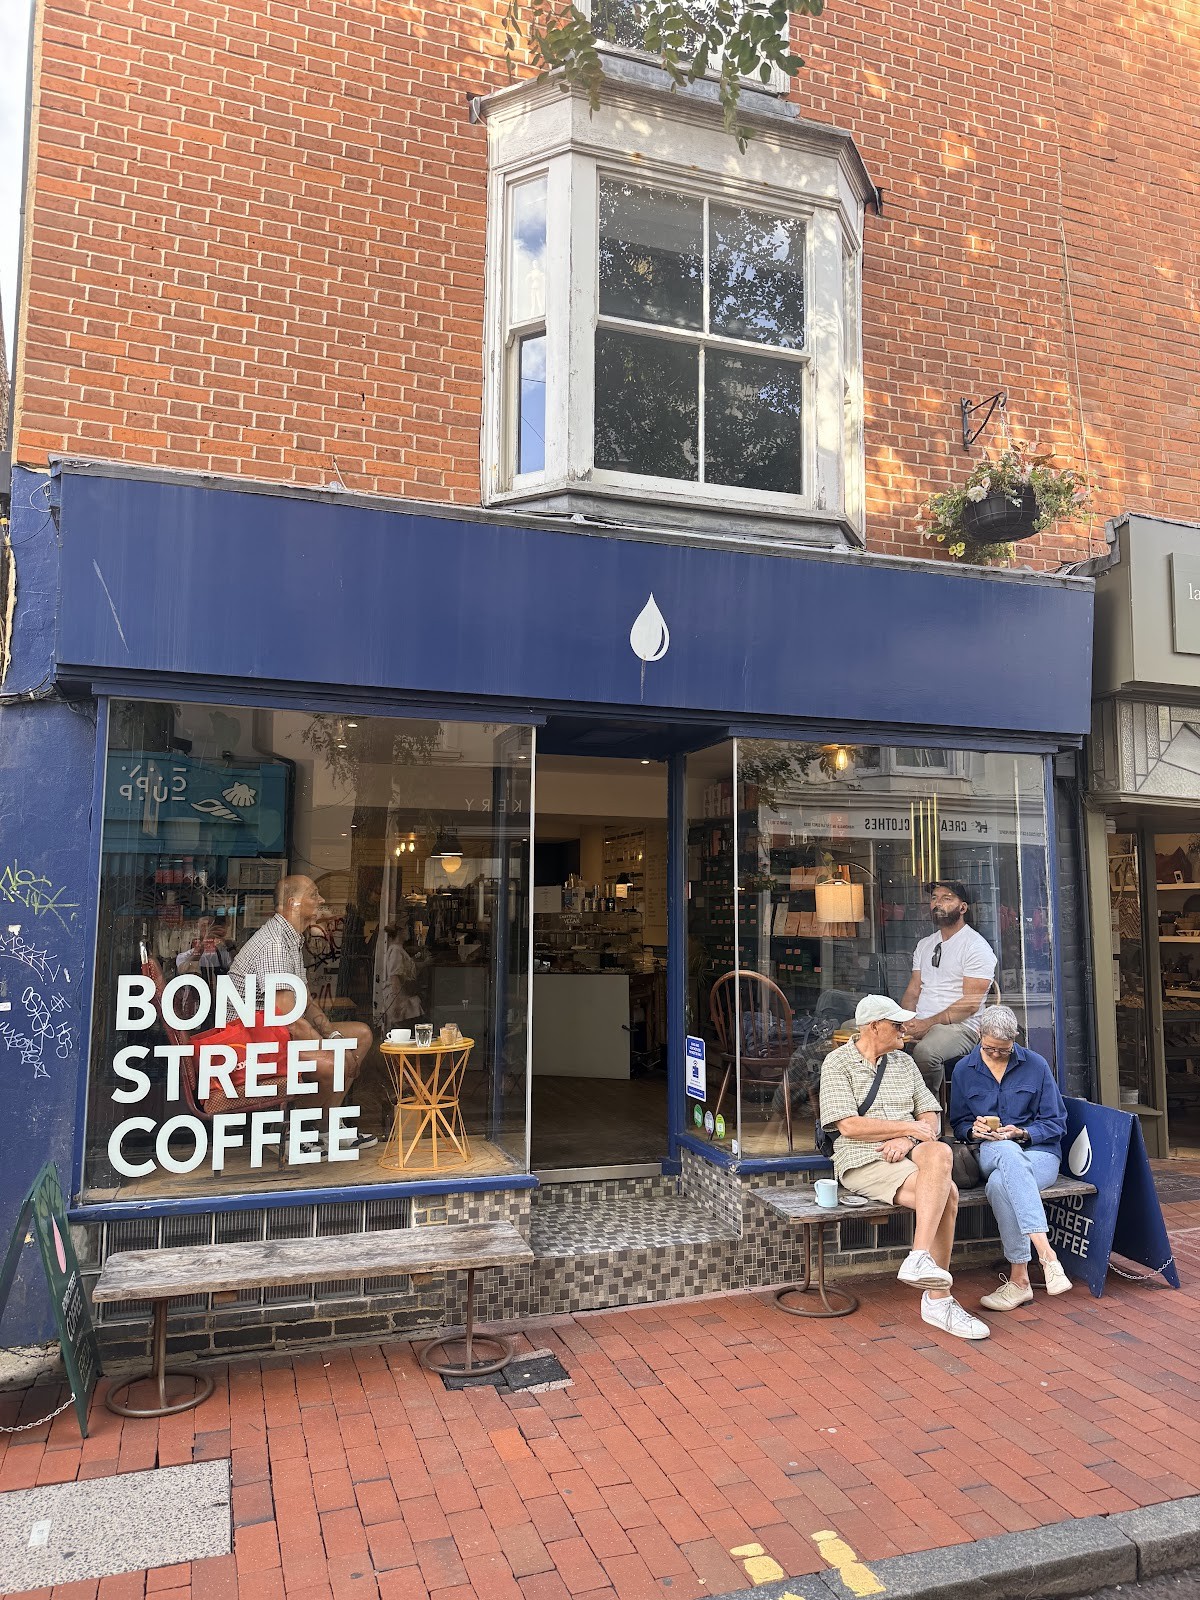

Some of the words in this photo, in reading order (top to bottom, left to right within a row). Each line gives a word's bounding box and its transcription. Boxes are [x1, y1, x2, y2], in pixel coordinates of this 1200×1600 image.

[115, 973, 308, 1031] BOND
[111, 1037, 358, 1104] STREET
[107, 1105, 361, 1178] COFFEE
[1047, 1224, 1090, 1259] OFFEE
